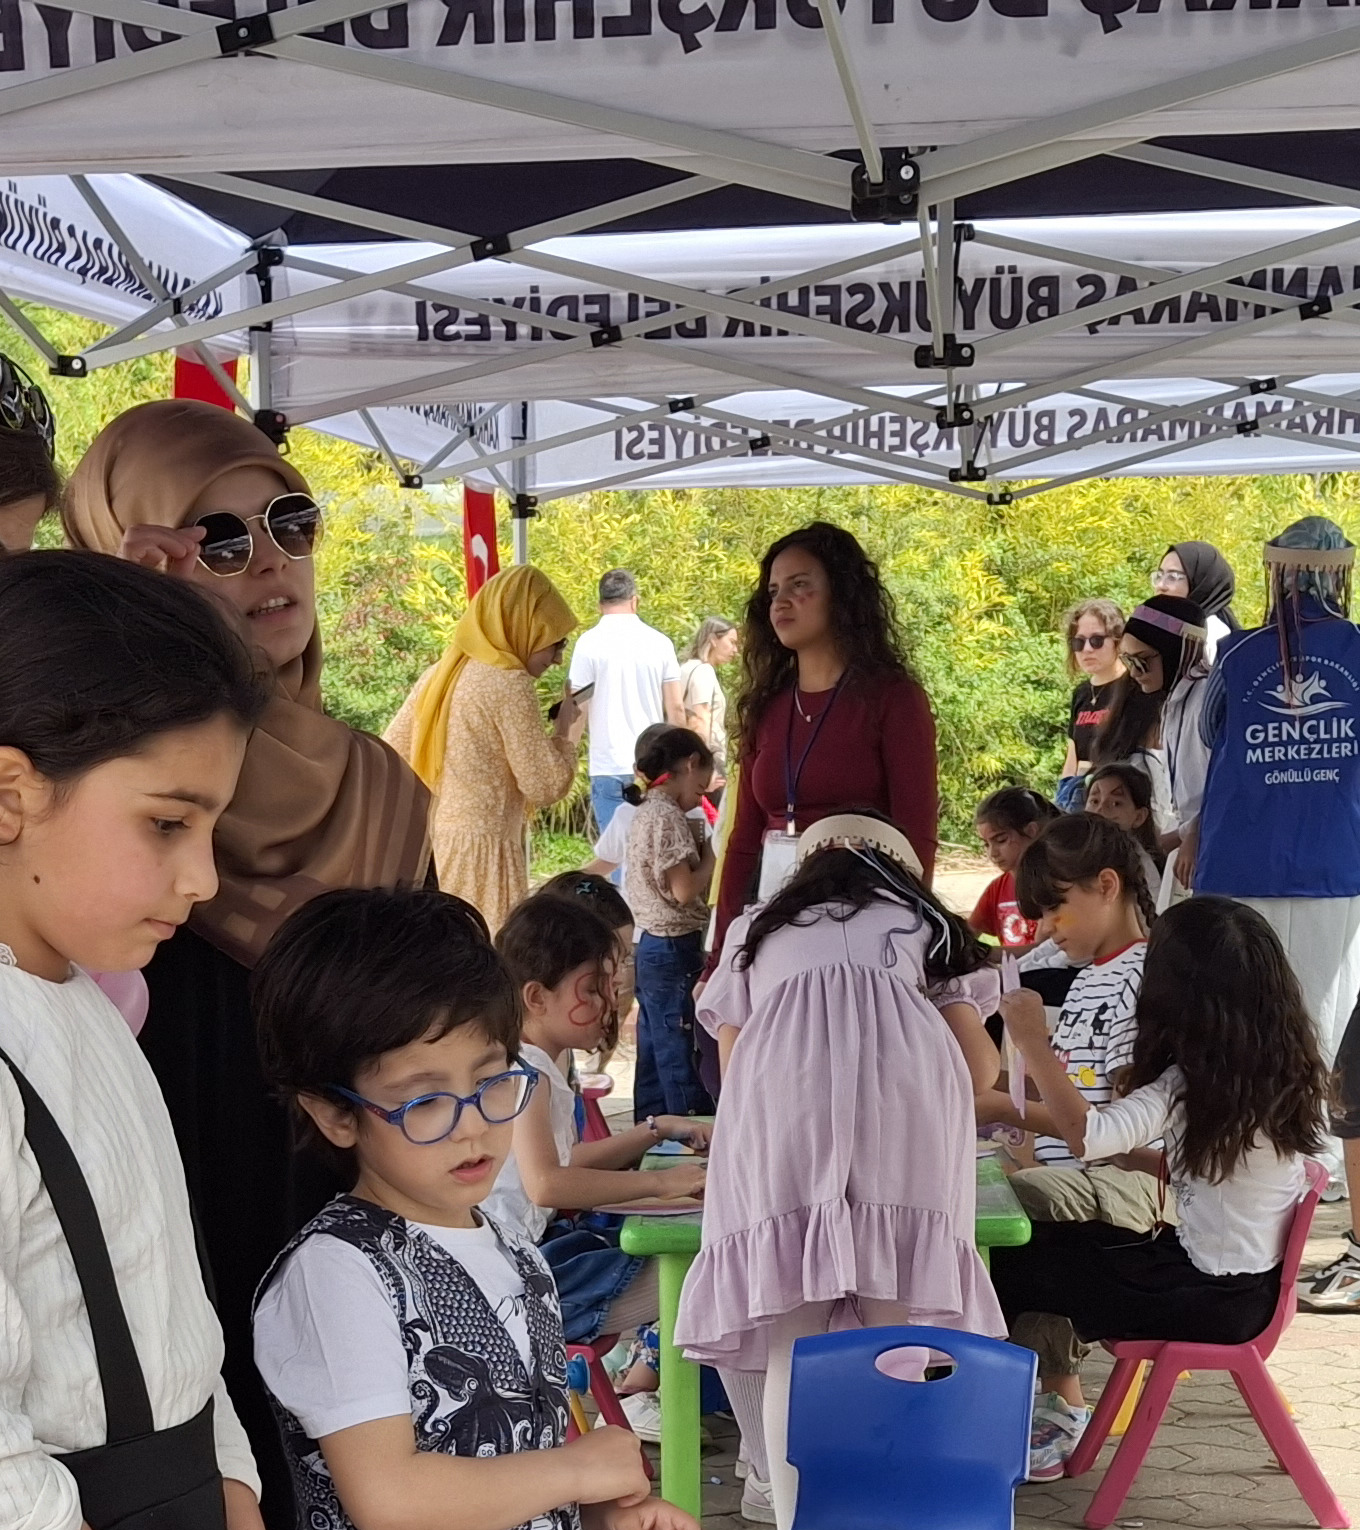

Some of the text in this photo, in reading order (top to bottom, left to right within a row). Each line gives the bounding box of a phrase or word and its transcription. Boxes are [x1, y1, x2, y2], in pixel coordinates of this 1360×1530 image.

[1253, 660, 1284, 687] GENÇLİ
[1245, 717, 1356, 744] GENÇLİK
[1246, 740, 1359, 764] MERKEZLERİ
[1265, 767, 1340, 784] GÖNÜLLÜ GENÇ
